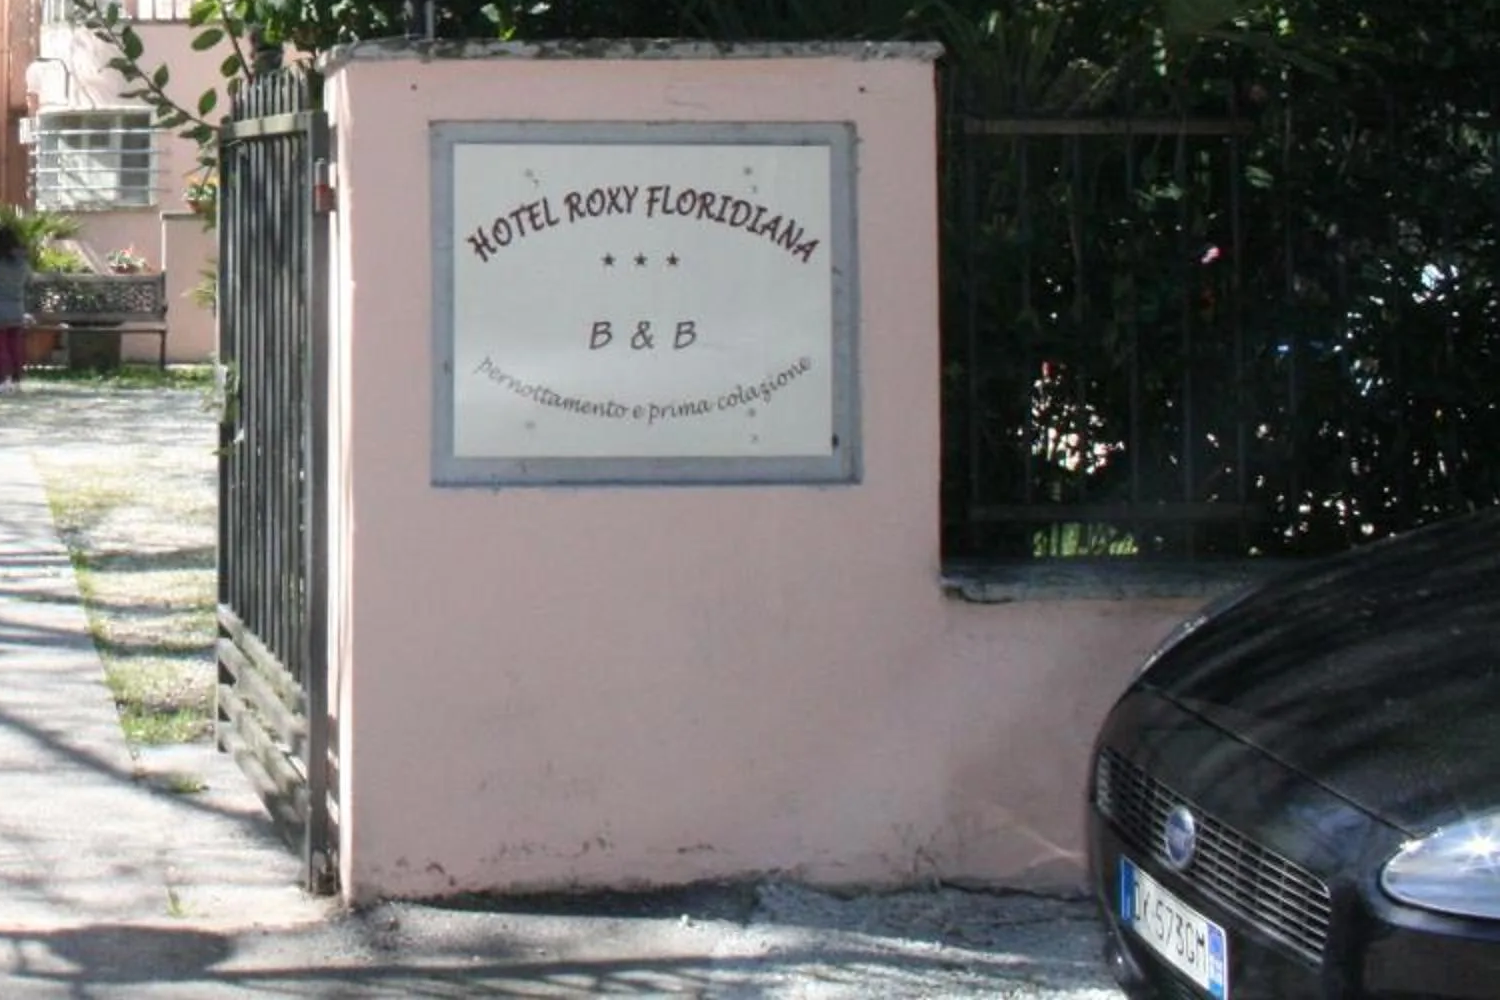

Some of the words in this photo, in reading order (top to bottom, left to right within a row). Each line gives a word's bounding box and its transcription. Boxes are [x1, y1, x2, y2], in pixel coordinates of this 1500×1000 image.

[466, 196, 560, 263] HOTEL
[563, 185, 639, 224] ROXY
[645, 185, 821, 264] FLORIDIANA
[588, 321, 614, 350] B
[629, 321, 655, 350] &
[672, 321, 697, 350] B
[472, 355, 629, 419] pernottamento
[631, 404, 647, 420] e
[648, 397, 713, 426] prima
[716, 356, 812, 411] colazione
